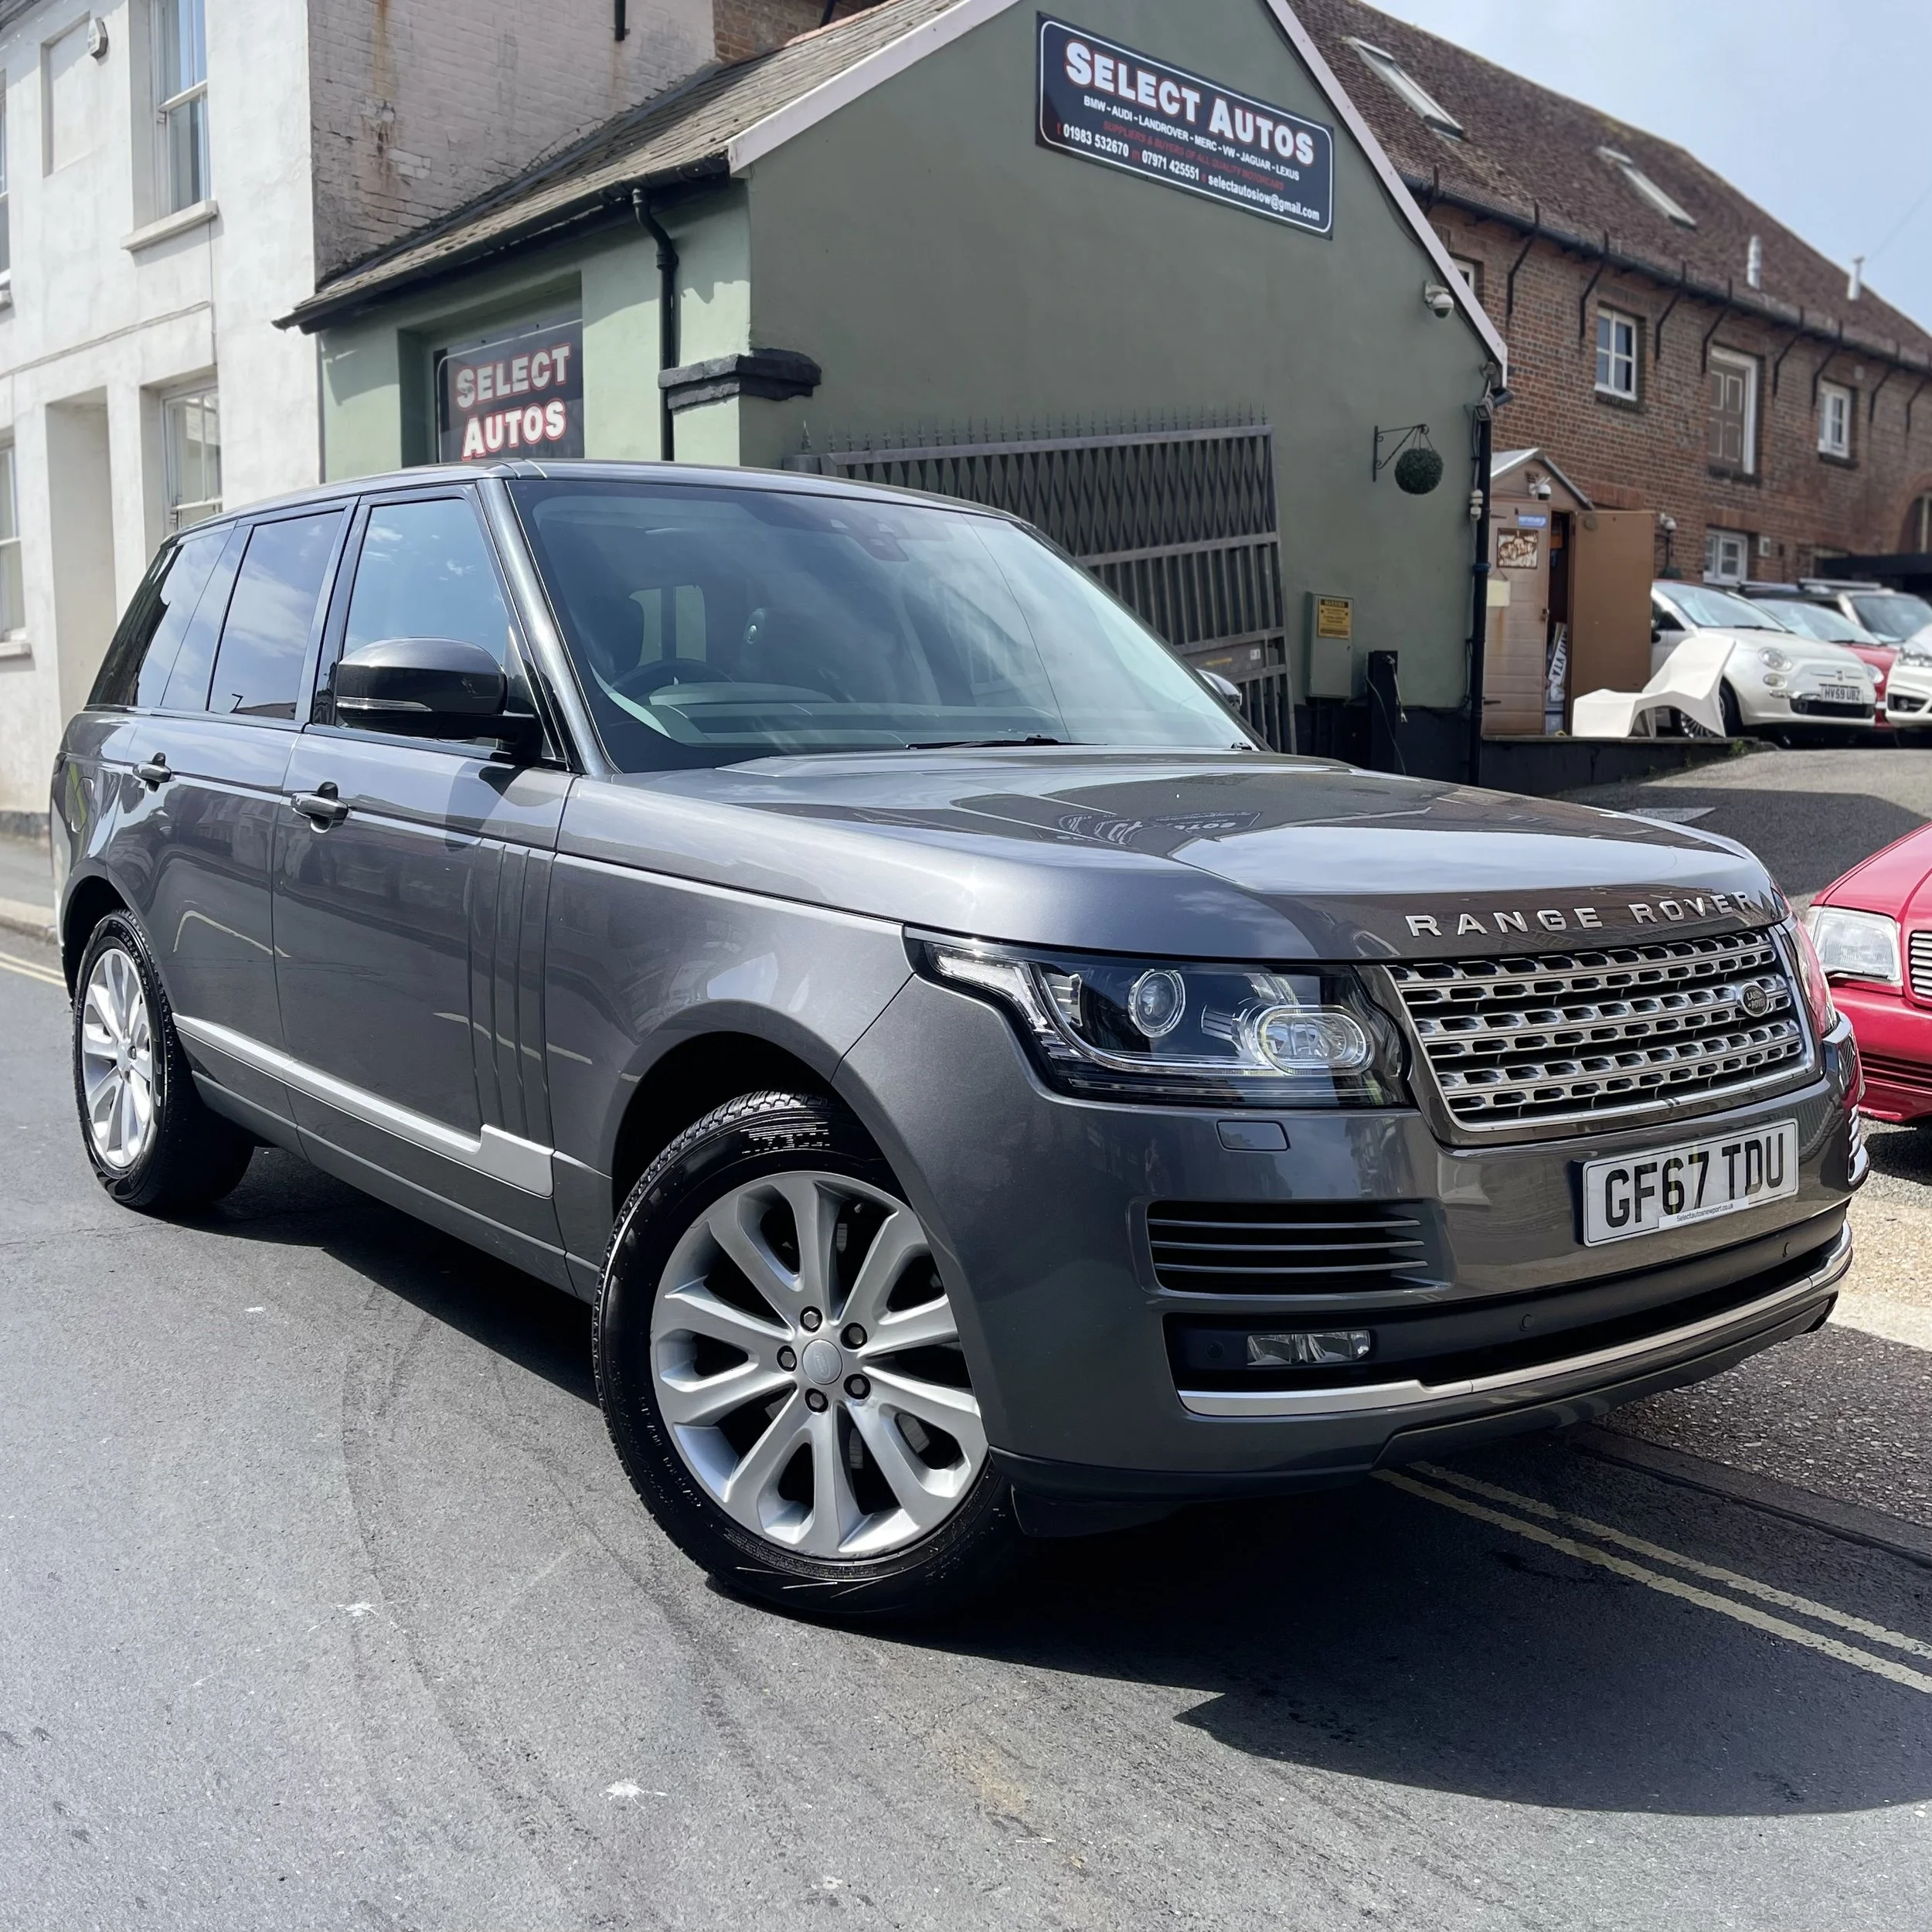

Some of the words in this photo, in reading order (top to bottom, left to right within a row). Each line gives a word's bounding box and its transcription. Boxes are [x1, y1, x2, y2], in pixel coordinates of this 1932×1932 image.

[1065, 40, 1201, 123] SELECT
[1208, 97, 1315, 166] AUTOS
[1083, 95, 1106, 112] BMW
[1111, 105, 1133, 121] AUDI
[1138, 114, 1189, 142] LANDROVER
[1195, 135, 1217, 151] MERC
[1223, 145, 1236, 158] VW
[1240, 151, 1271, 172] JAGUAR
[1276, 164, 1300, 181] LEXUS
[1063, 124, 1092, 145] 01983
[1094, 134, 1129, 157] 532670
[1141, 150, 1167, 170] 07971
[1168, 161, 1199, 181] 425551
[1208, 174, 1320, 221] selectautosiow@gmail.com
[1103, 120, 1146, 143] SUPPLIERS
[1155, 138, 1185, 156] BUYERS
[1185, 149, 1196, 159] OF
[1196, 153, 1209, 165] ALL
[1212, 158, 1242, 175] QUALITY
[456, 345, 570, 409] SELECT
[462, 400, 566, 458] AUTOS
[1405, 907, 1603, 937] RANGE
[1628, 891, 1754, 924] ROVER
[1605, 1151, 1709, 1229] GF67
[1721, 1132, 1784, 1199] TDU
